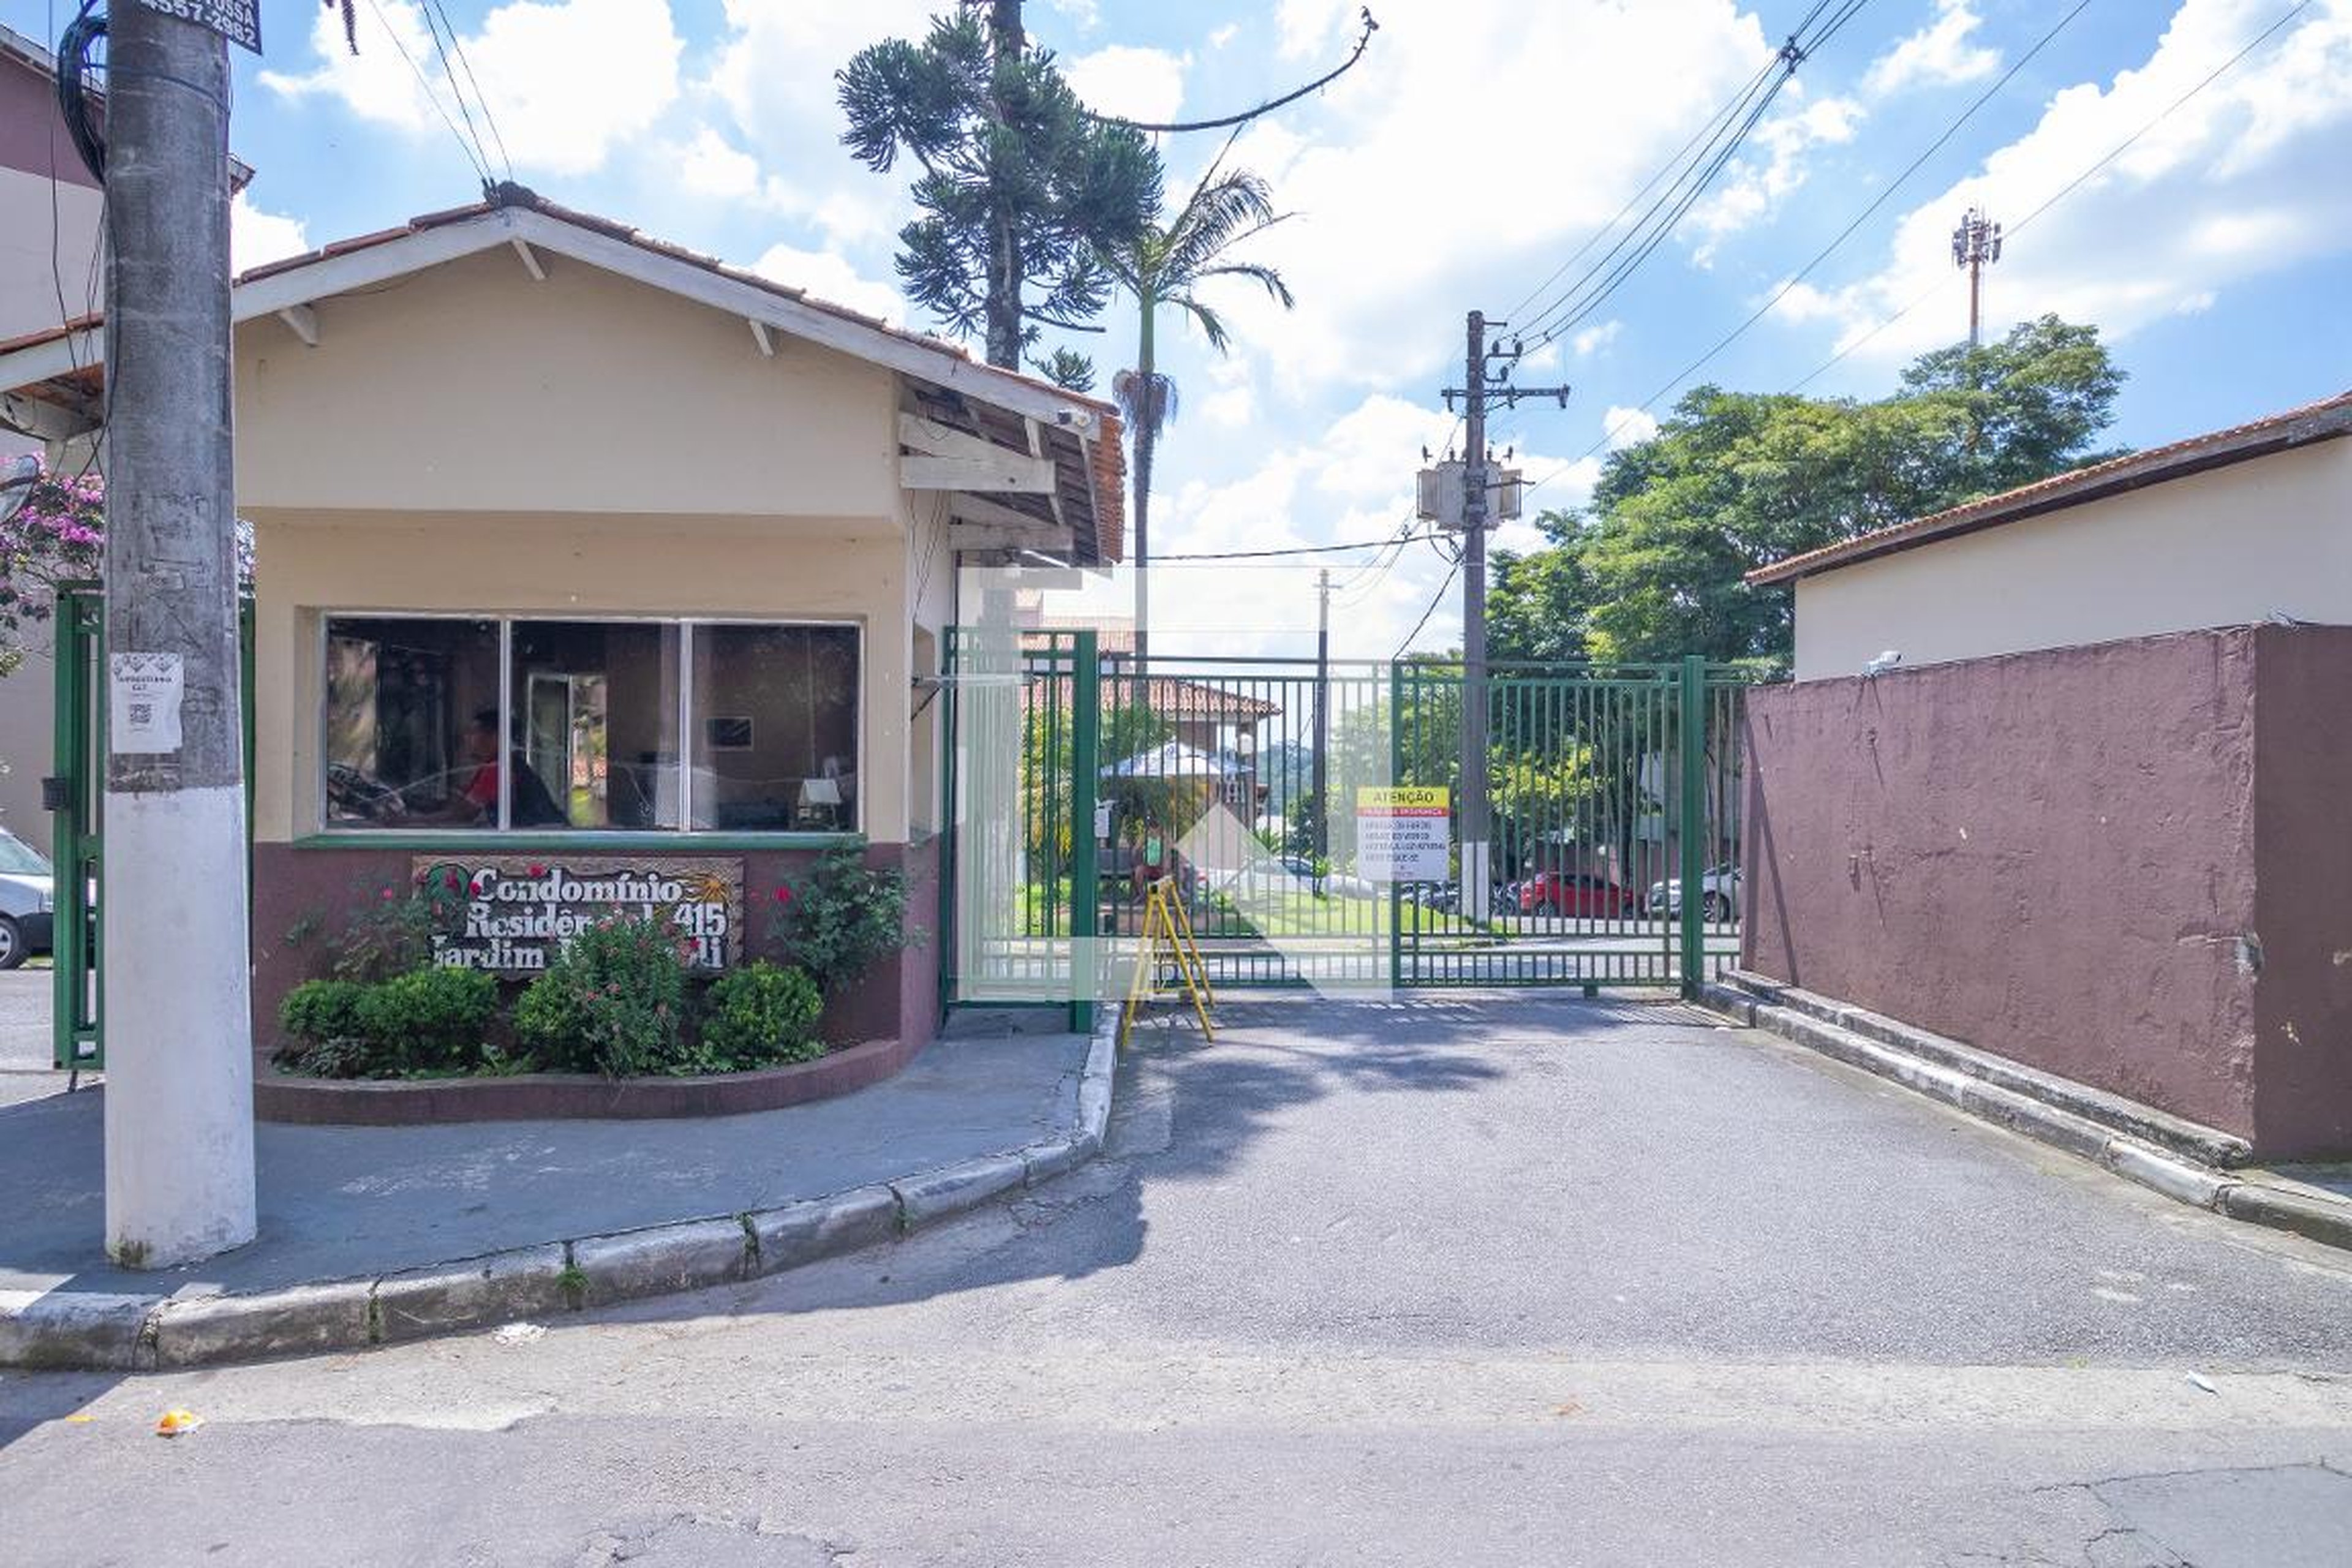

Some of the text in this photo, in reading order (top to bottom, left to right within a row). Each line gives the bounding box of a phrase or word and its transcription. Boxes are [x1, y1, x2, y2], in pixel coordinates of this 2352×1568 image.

[1374, 790, 1434, 804] ATENÇÃO
[470, 869, 682, 902] Condomínio
[673, 902, 726, 937] 415
